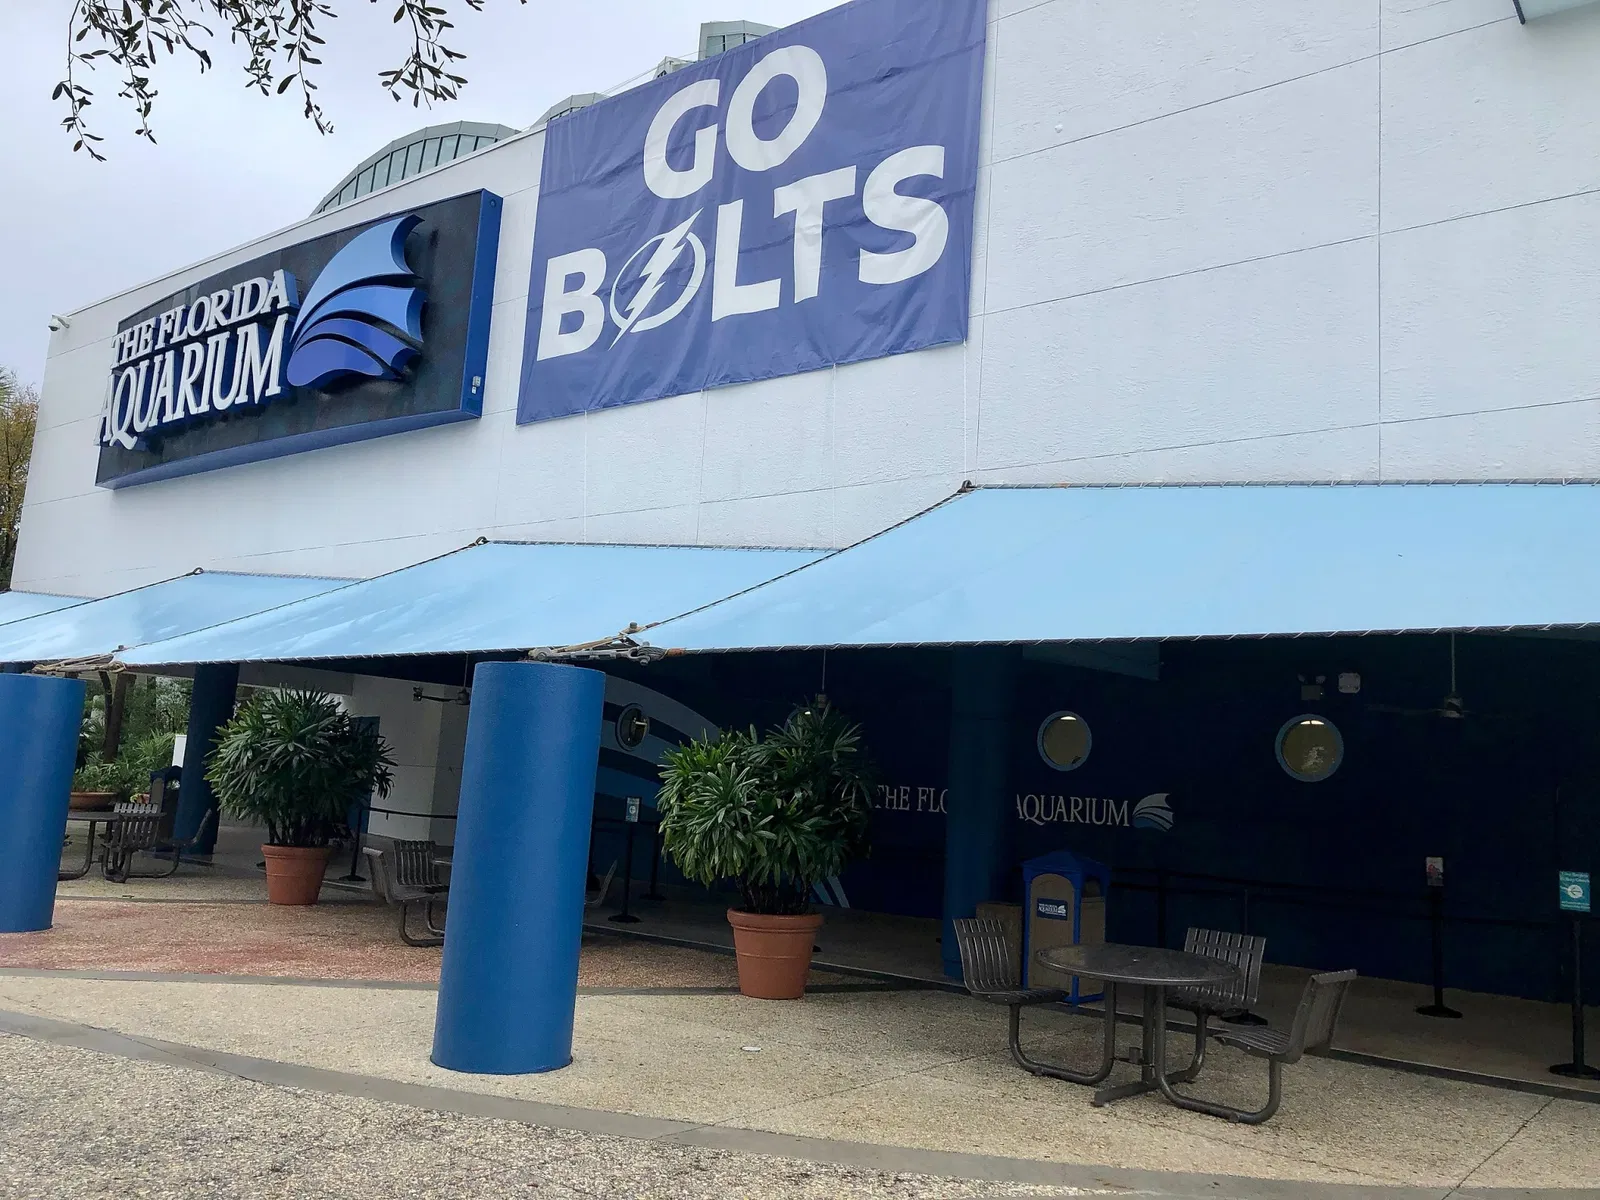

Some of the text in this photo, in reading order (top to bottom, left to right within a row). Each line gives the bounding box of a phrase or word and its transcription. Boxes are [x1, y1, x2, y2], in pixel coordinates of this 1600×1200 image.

[643, 44, 828, 199] GO
[111, 269, 290, 370] THE FLORIDA
[536, 145, 950, 361] BOLTS
[94, 312, 289, 450] AQUARIUM
